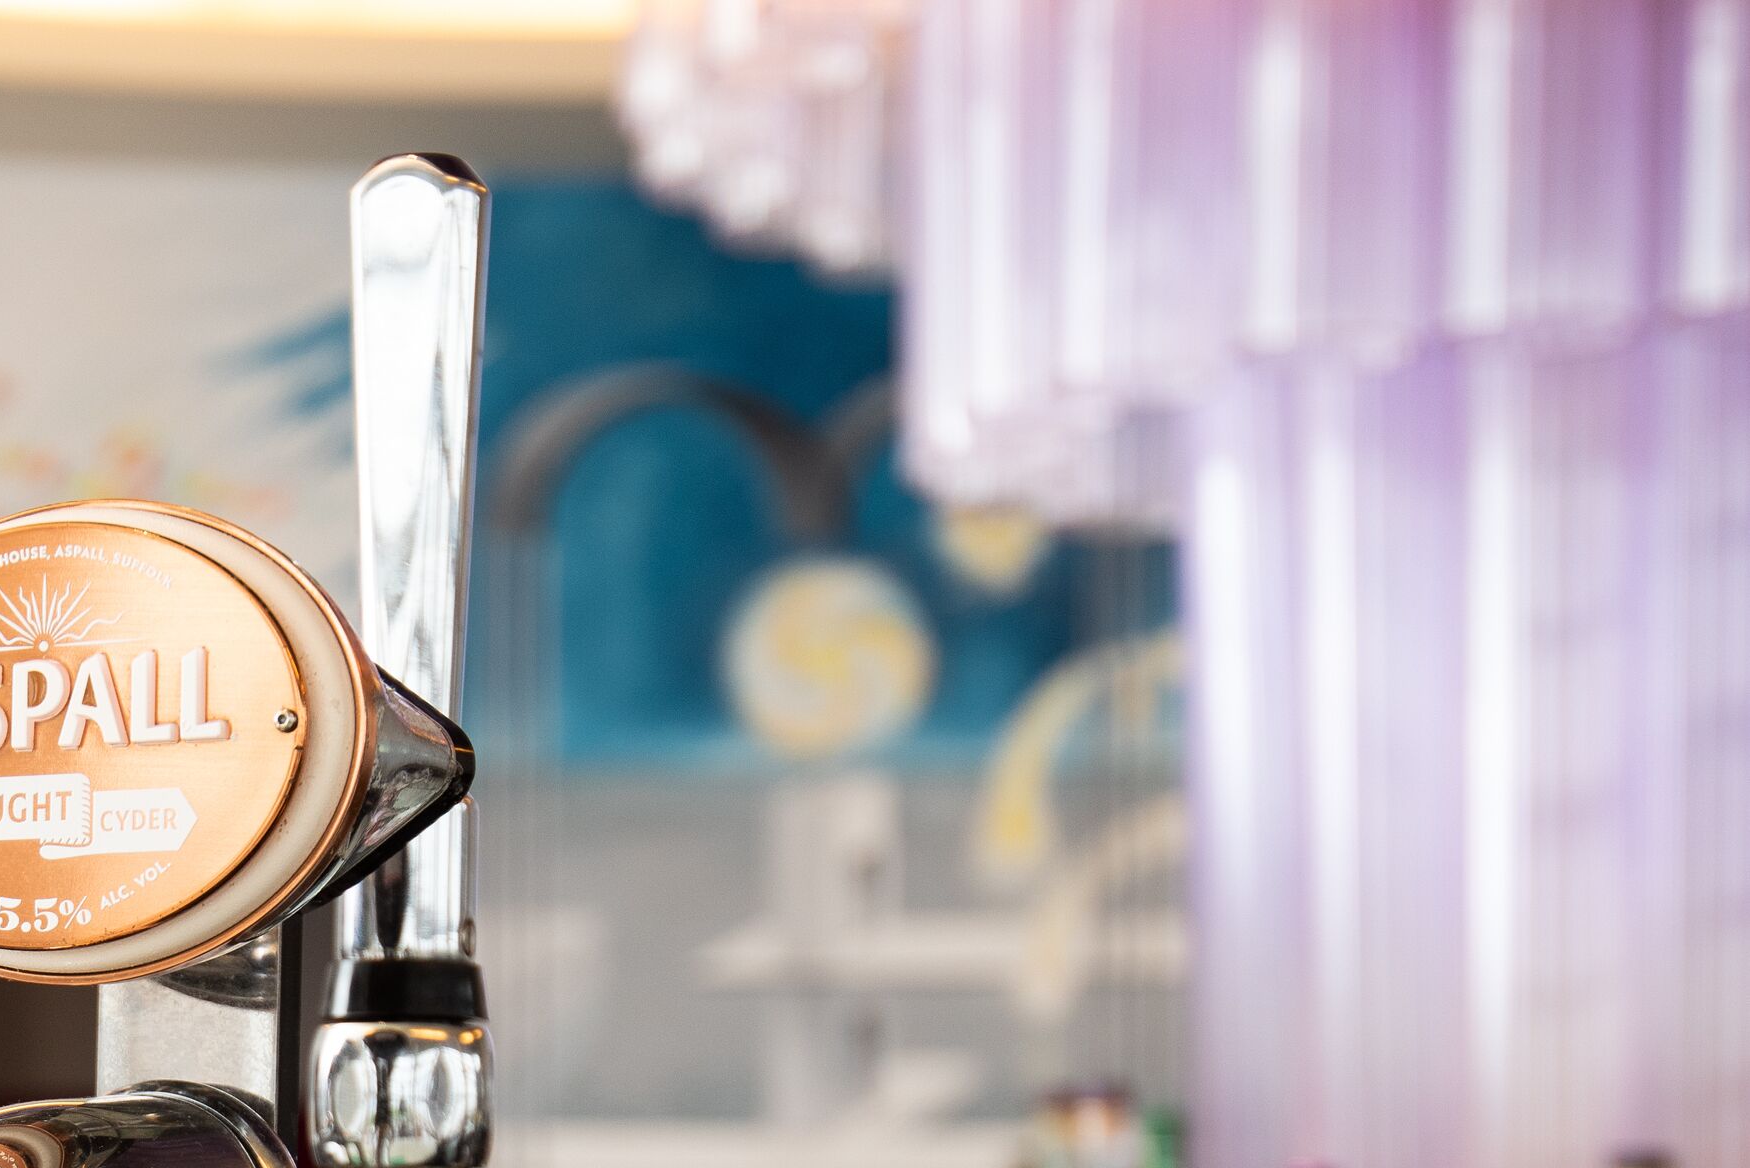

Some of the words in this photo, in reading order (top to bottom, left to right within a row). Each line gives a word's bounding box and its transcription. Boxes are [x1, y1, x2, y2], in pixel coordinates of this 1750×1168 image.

[100, 806, 179, 833] CYDER
[100, 884, 135, 911] ALC.
[133, 860, 171, 888] VOL.
